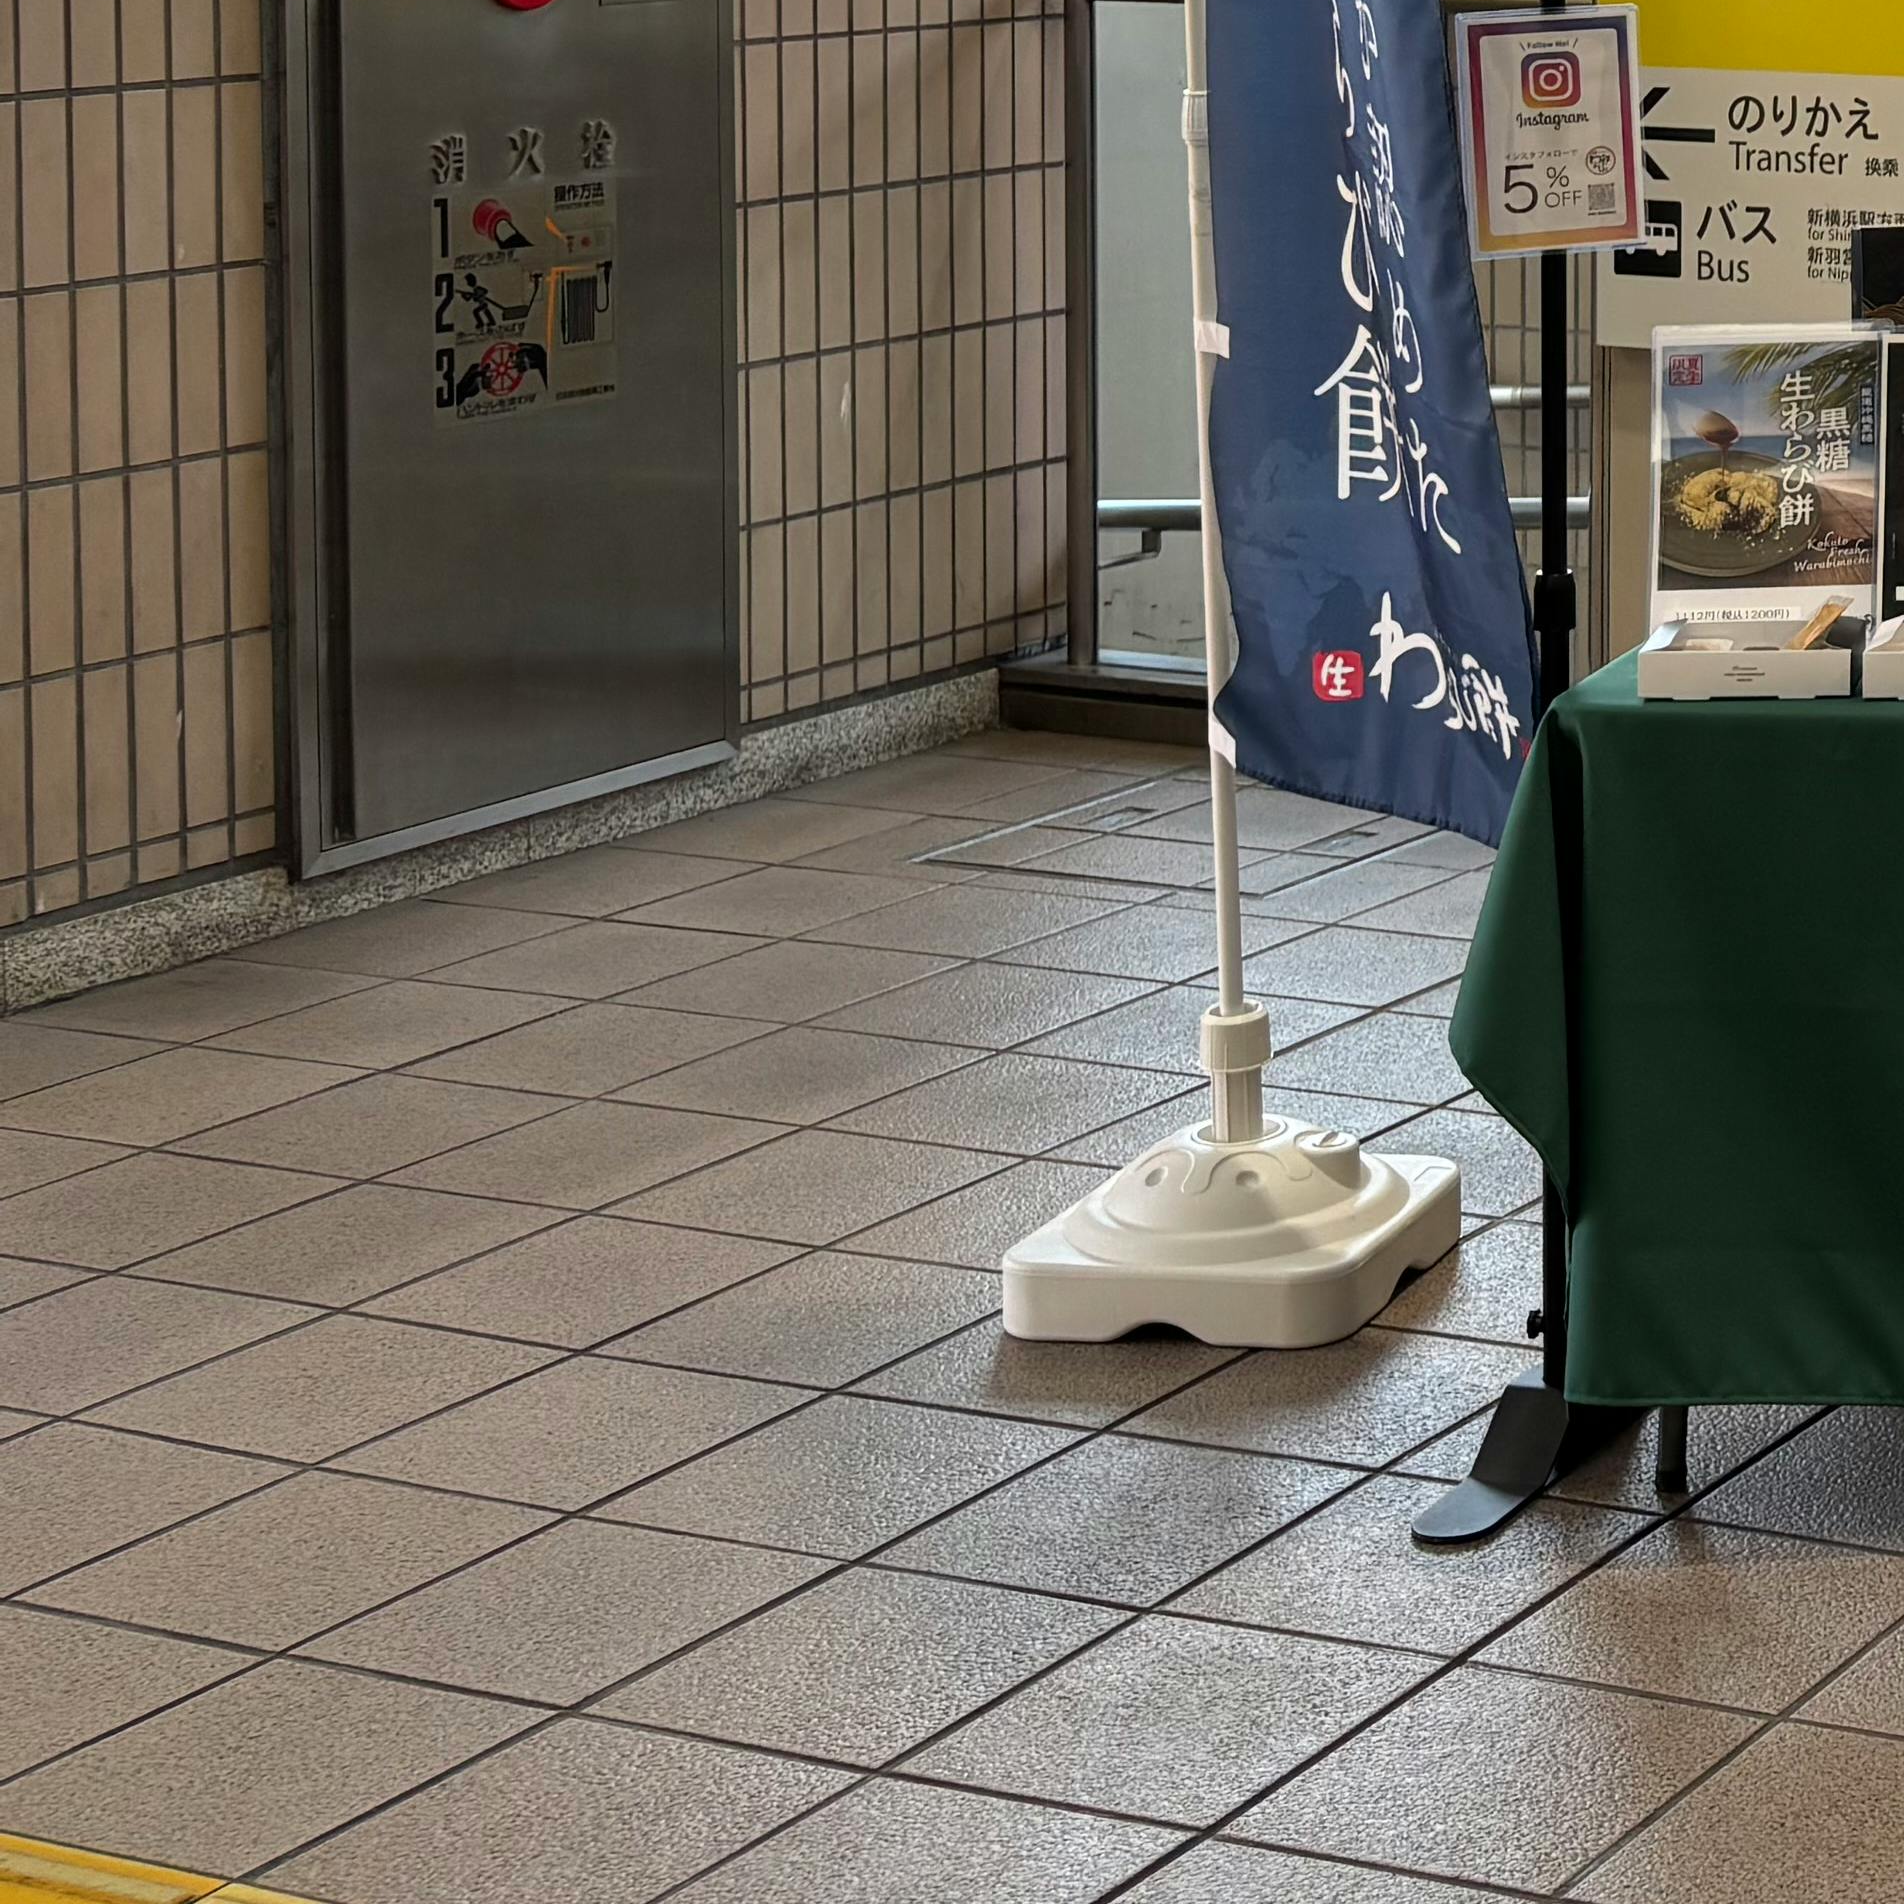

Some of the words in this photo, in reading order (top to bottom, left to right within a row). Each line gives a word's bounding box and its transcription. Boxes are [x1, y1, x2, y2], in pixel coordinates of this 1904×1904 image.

[1515, 111, 1590, 130] Instagram
[1727, 94, 1880, 141] のりかえ
[429, 120, 617, 187] 消火栓
[1728, 140, 1849, 175] Transfer
[1503, 163, 1539, 214] 5
[1546, 165, 1570, 188] %
[1544, 191, 1583, 209] OFF
[433, 198, 449, 258] 1
[1696, 198, 1778, 245] バス
[1808, 227, 1826, 242] for
[1697, 249, 1751, 284] Bus
[1808, 266, 1826, 280] for
[435, 273, 454, 334] 2
[435, 347, 455, 408] 3
[1777, 370, 1816, 529] 生わらび餅
[1815, 406, 1850, 474] 黒糖
[1320, 653, 1356, 697] 生
